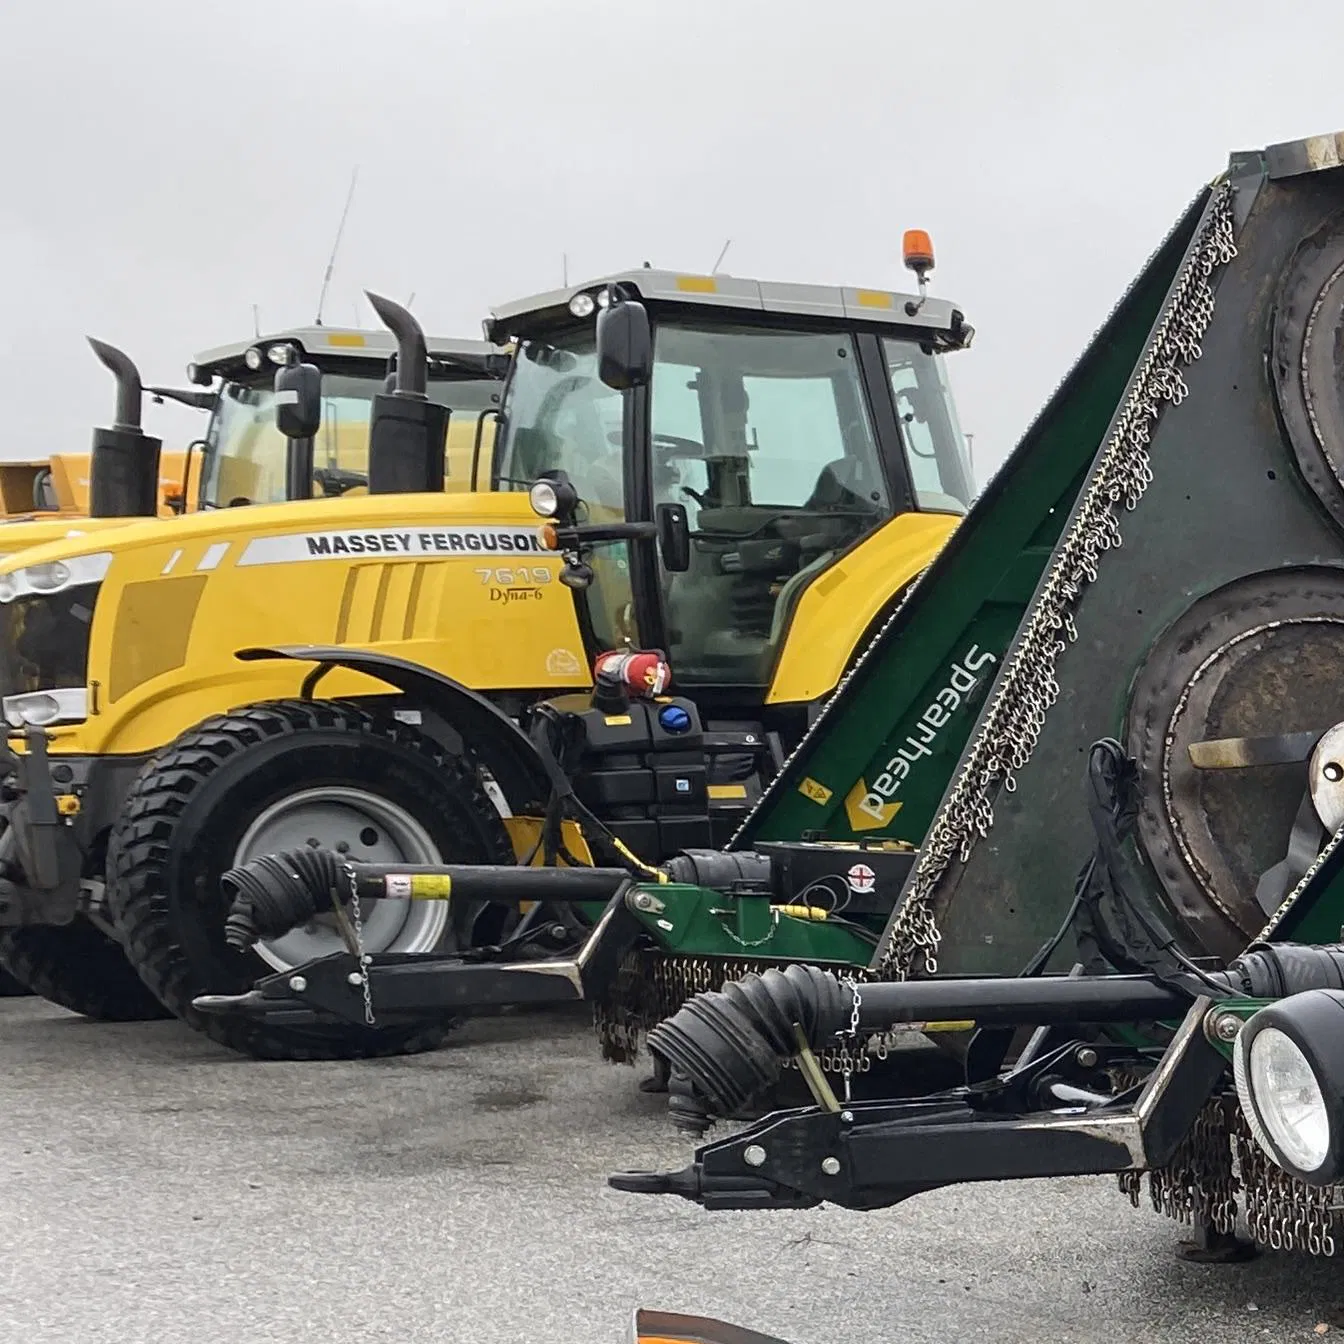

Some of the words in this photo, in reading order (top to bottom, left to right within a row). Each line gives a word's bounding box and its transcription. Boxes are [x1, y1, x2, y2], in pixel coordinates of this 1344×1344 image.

[305, 533, 411, 555] MASSEY
[474, 567, 552, 585] 7619
[490, 587, 543, 605] Dyna-6
[858, 644, 997, 821] Spearhead
